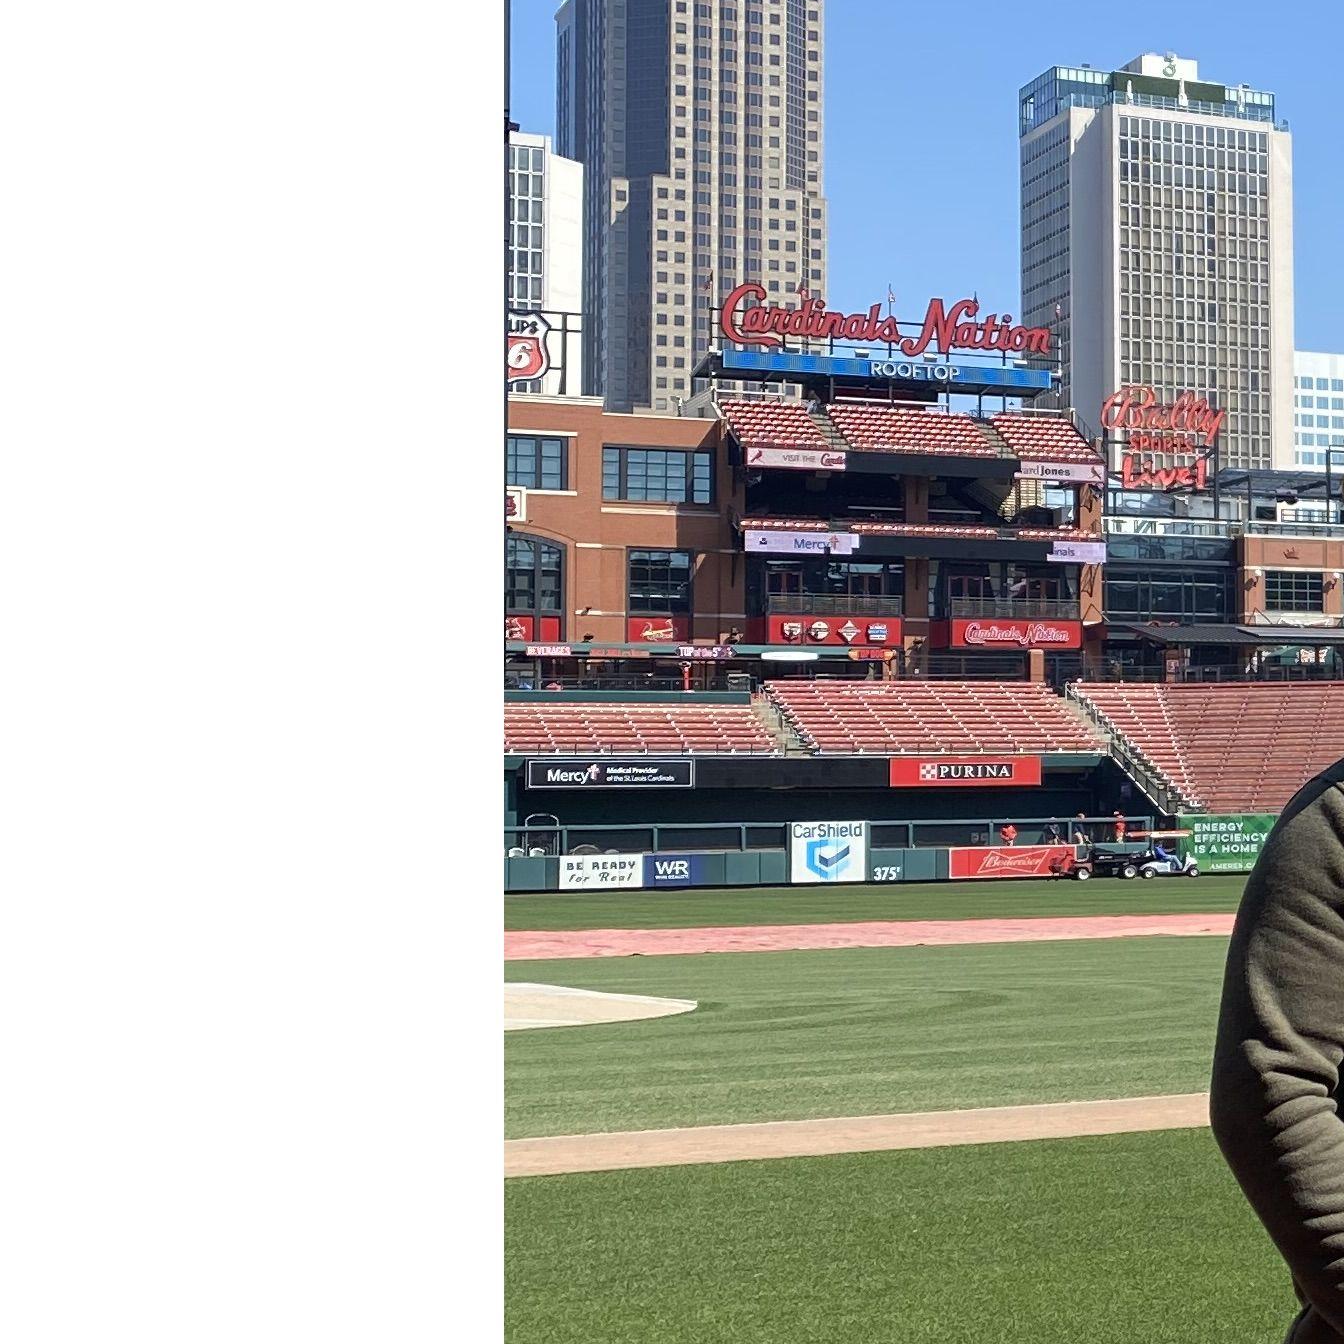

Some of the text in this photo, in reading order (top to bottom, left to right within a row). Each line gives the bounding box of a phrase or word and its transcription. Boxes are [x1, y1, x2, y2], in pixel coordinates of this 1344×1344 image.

[721, 283, 1051, 355] Cardinals Nation
[871, 361, 961, 381] ROOFTOP
[1101, 386, 1225, 446] Bally
[1130, 435, 1195, 453] SPORTS
[1041, 465, 1071, 476] Jones
[1123, 456, 1206, 489] Live!
[793, 538, 831, 552] Mercy
[964, 622, 1069, 645] Cardinals Nation
[547, 769, 589, 784] Mercy
[939, 763, 1011, 778] PURINA
[792, 823, 863, 838] CarShield
[1194, 822, 1243, 832] ENERGY
[1194, 832, 1268, 843] EFFICIENCY
[1194, 843, 1258, 854] IS A HOME
[566, 861, 636, 871] BE READY
[985, 849, 1042, 869] Budweiser
[655, 860, 689, 875] WR
[873, 866, 901, 881] 375'
[569, 872, 633, 883] for Real
